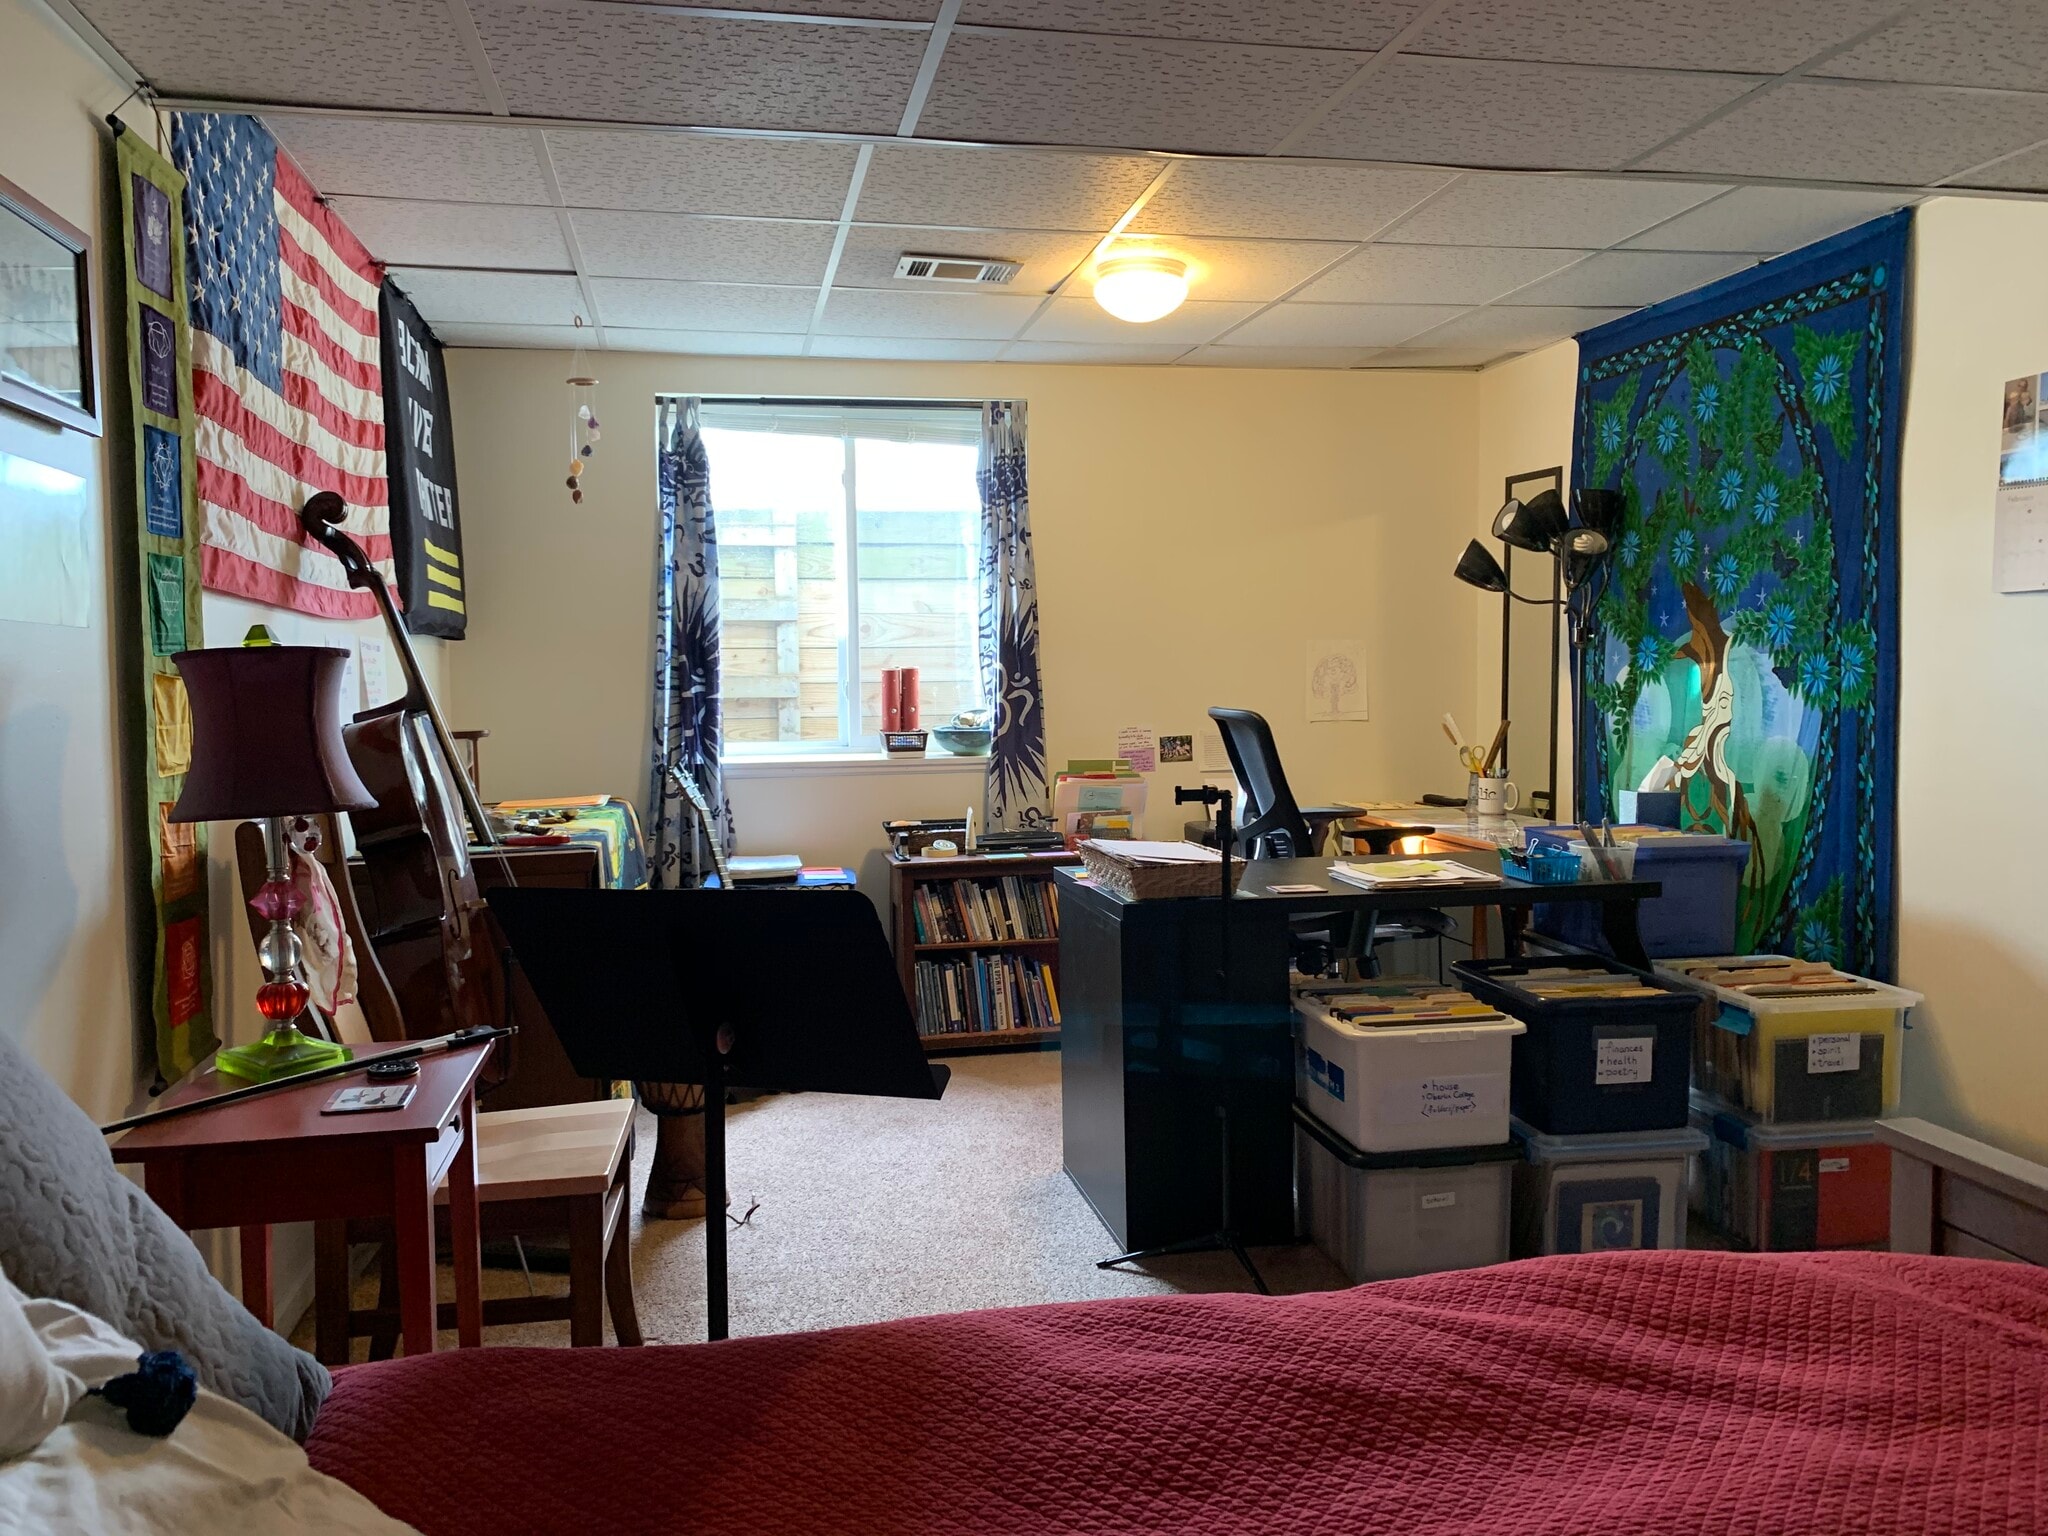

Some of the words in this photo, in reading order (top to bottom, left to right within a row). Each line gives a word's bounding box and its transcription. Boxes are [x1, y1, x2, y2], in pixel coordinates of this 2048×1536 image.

[1605, 1041, 1643, 1053] finances
[1606, 1055, 1637, 1066] health
[1431, 1079, 1460, 1092] house
